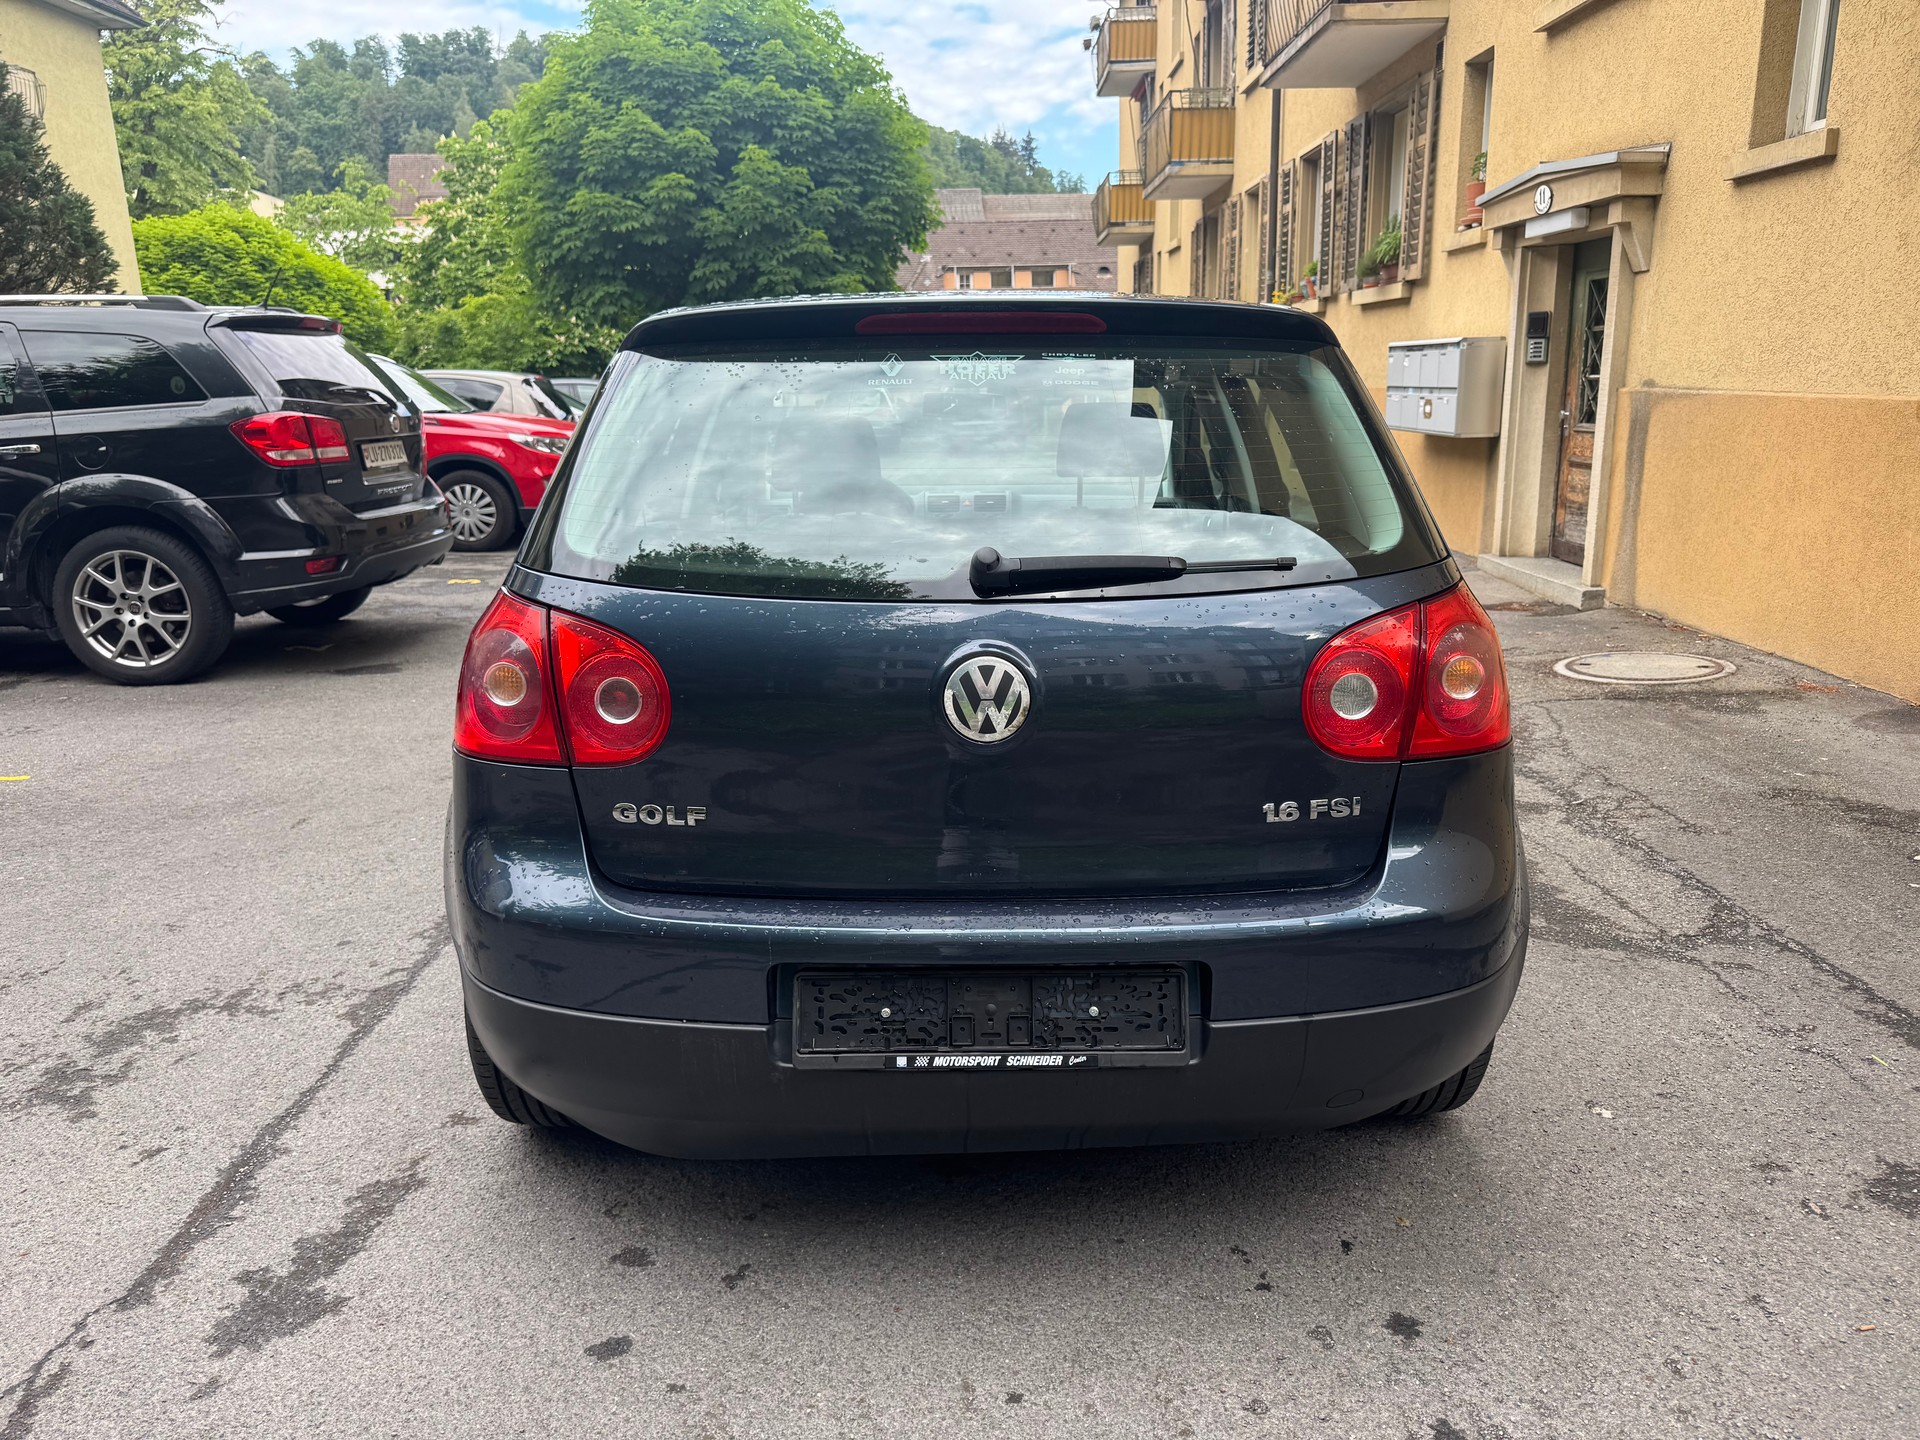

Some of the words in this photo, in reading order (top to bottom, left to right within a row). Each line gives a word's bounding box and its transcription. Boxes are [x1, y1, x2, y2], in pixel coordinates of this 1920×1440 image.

[1539, 187, 1546, 205] 11
[940, 363, 1017, 375] HOFER
[1054, 366, 1085, 376] Jeep
[944, 656, 1031, 743] VW
[612, 802, 707, 826] GOLF
[1309, 796, 1361, 820] FSI
[933, 1056, 1001, 1067] MOTORSPORT
[1006, 1055, 1063, 1066] SCHNEIDER
